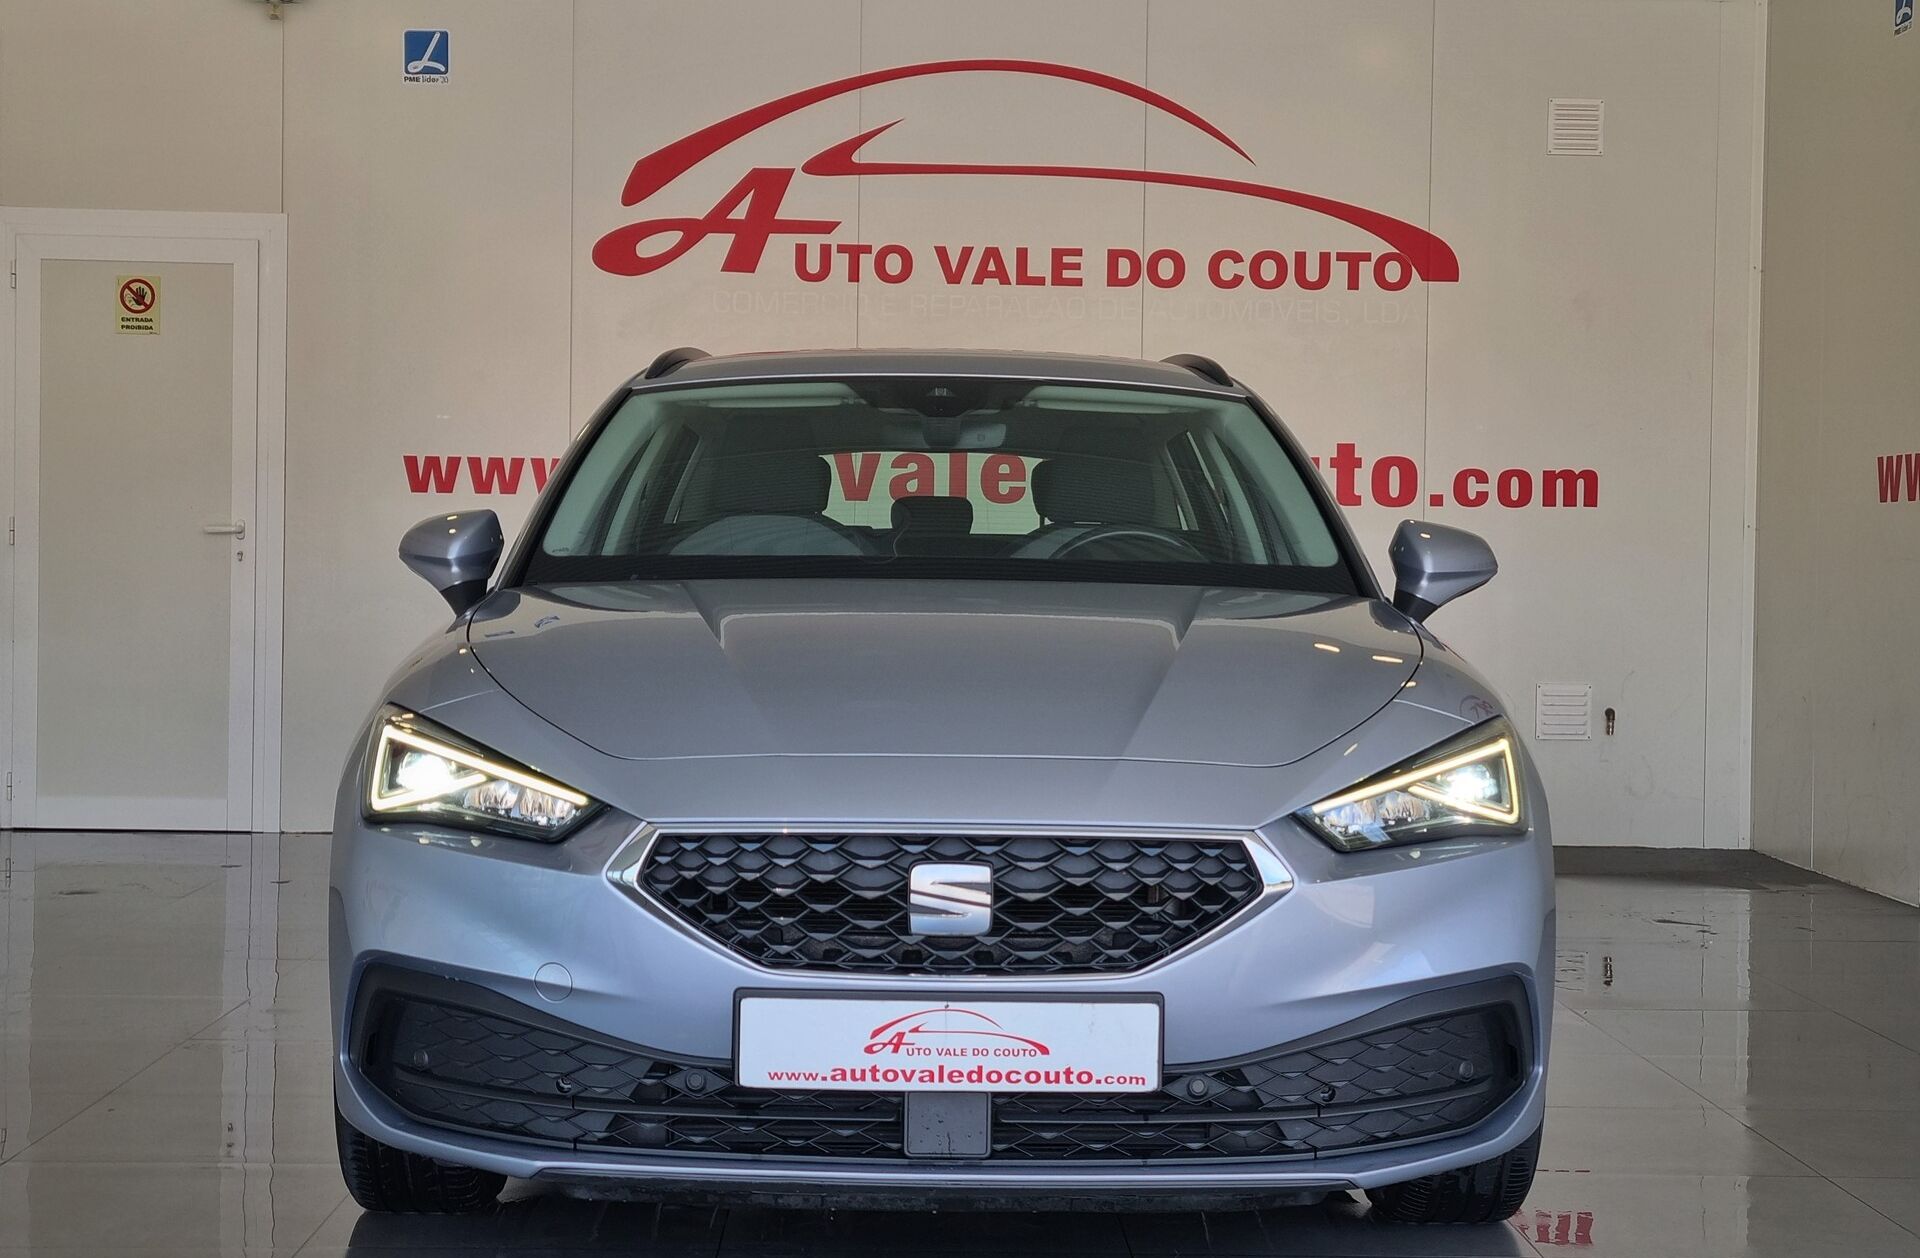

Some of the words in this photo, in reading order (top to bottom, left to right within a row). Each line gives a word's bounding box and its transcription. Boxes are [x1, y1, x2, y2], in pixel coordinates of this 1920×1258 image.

[591, 167, 914, 285] AUTO
[934, 243, 1085, 288] VALE
[1105, 248, 1188, 290] DO
[1206, 249, 1413, 292] COUTO
[863, 1031, 932, 1057] AUTO
[935, 1047, 968, 1057] VALE
[972, 1048, 989, 1057] DO
[993, 1048, 1037, 1058] COUTO
[767, 1064, 1146, 1086] www.autovaledocouto.com
